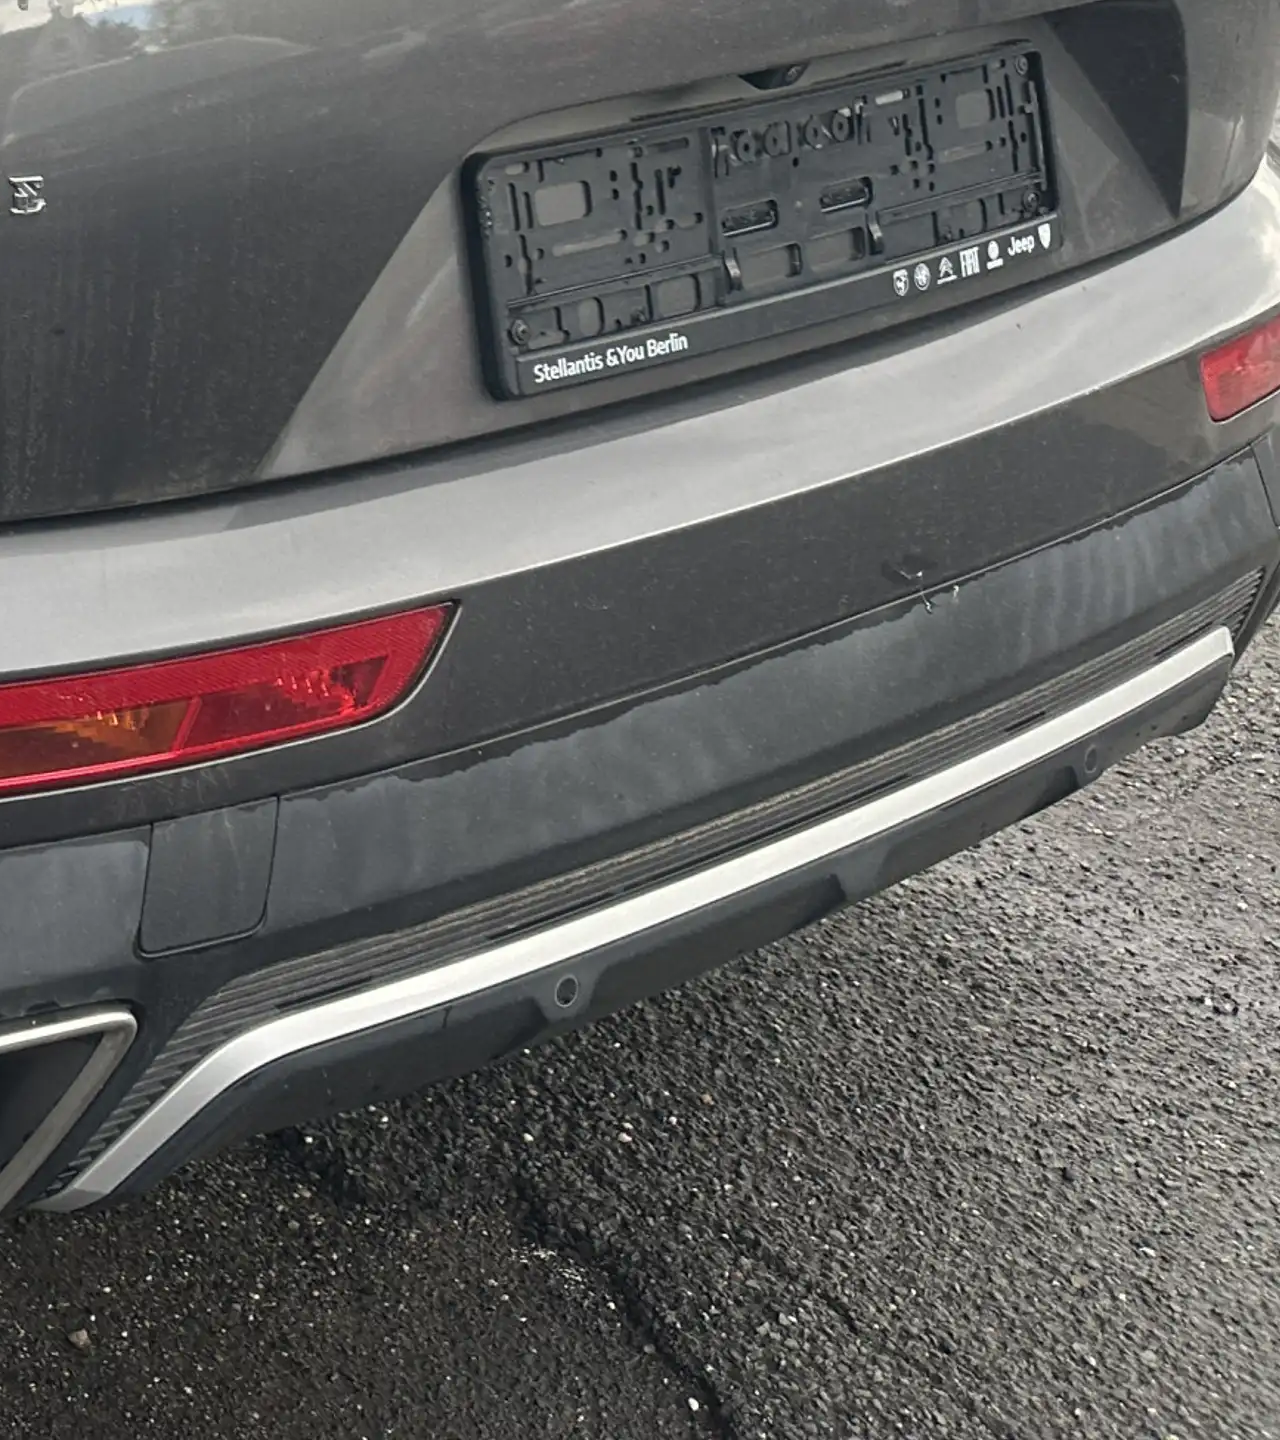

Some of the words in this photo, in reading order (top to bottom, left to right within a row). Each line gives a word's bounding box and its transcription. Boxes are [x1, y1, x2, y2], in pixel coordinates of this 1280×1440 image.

[1007, 235, 1035, 257] Jeep
[532, 351, 604, 384] Stellantis
[646, 332, 689, 358] Berlin
